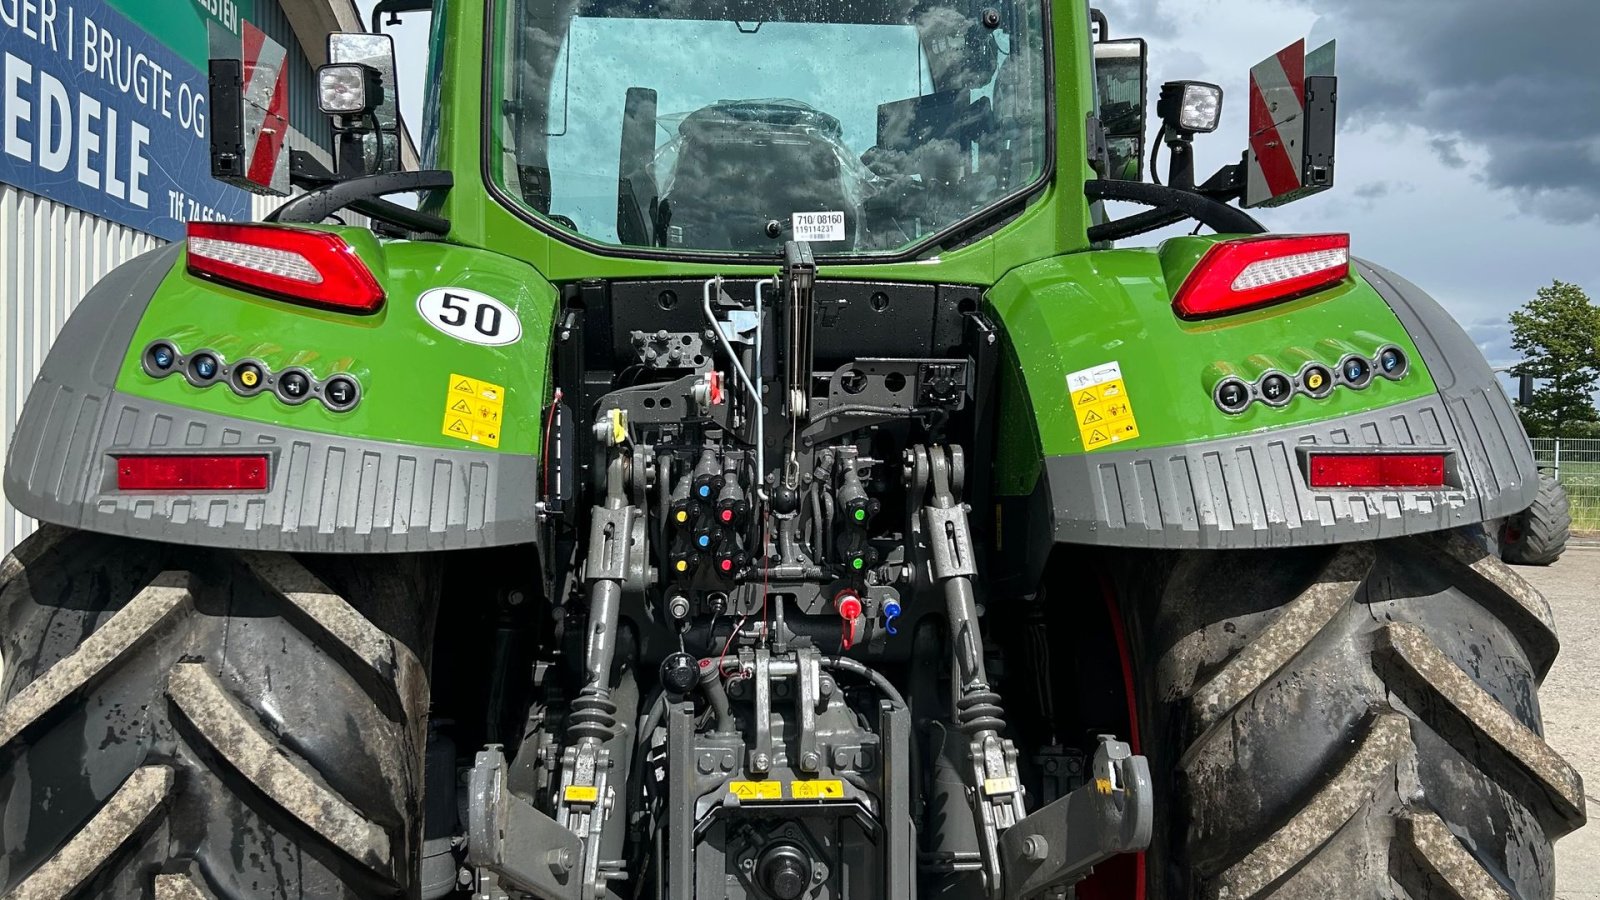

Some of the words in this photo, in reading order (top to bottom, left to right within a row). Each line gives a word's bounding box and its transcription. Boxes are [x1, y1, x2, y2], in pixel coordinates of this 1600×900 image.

[84, 16, 172, 118] BRUGTE
[178, 83, 204, 138] OG
[5, 51, 150, 209] EDELE
[169, 190, 185, 223] Tlf.
[439, 292, 502, 336] 50
